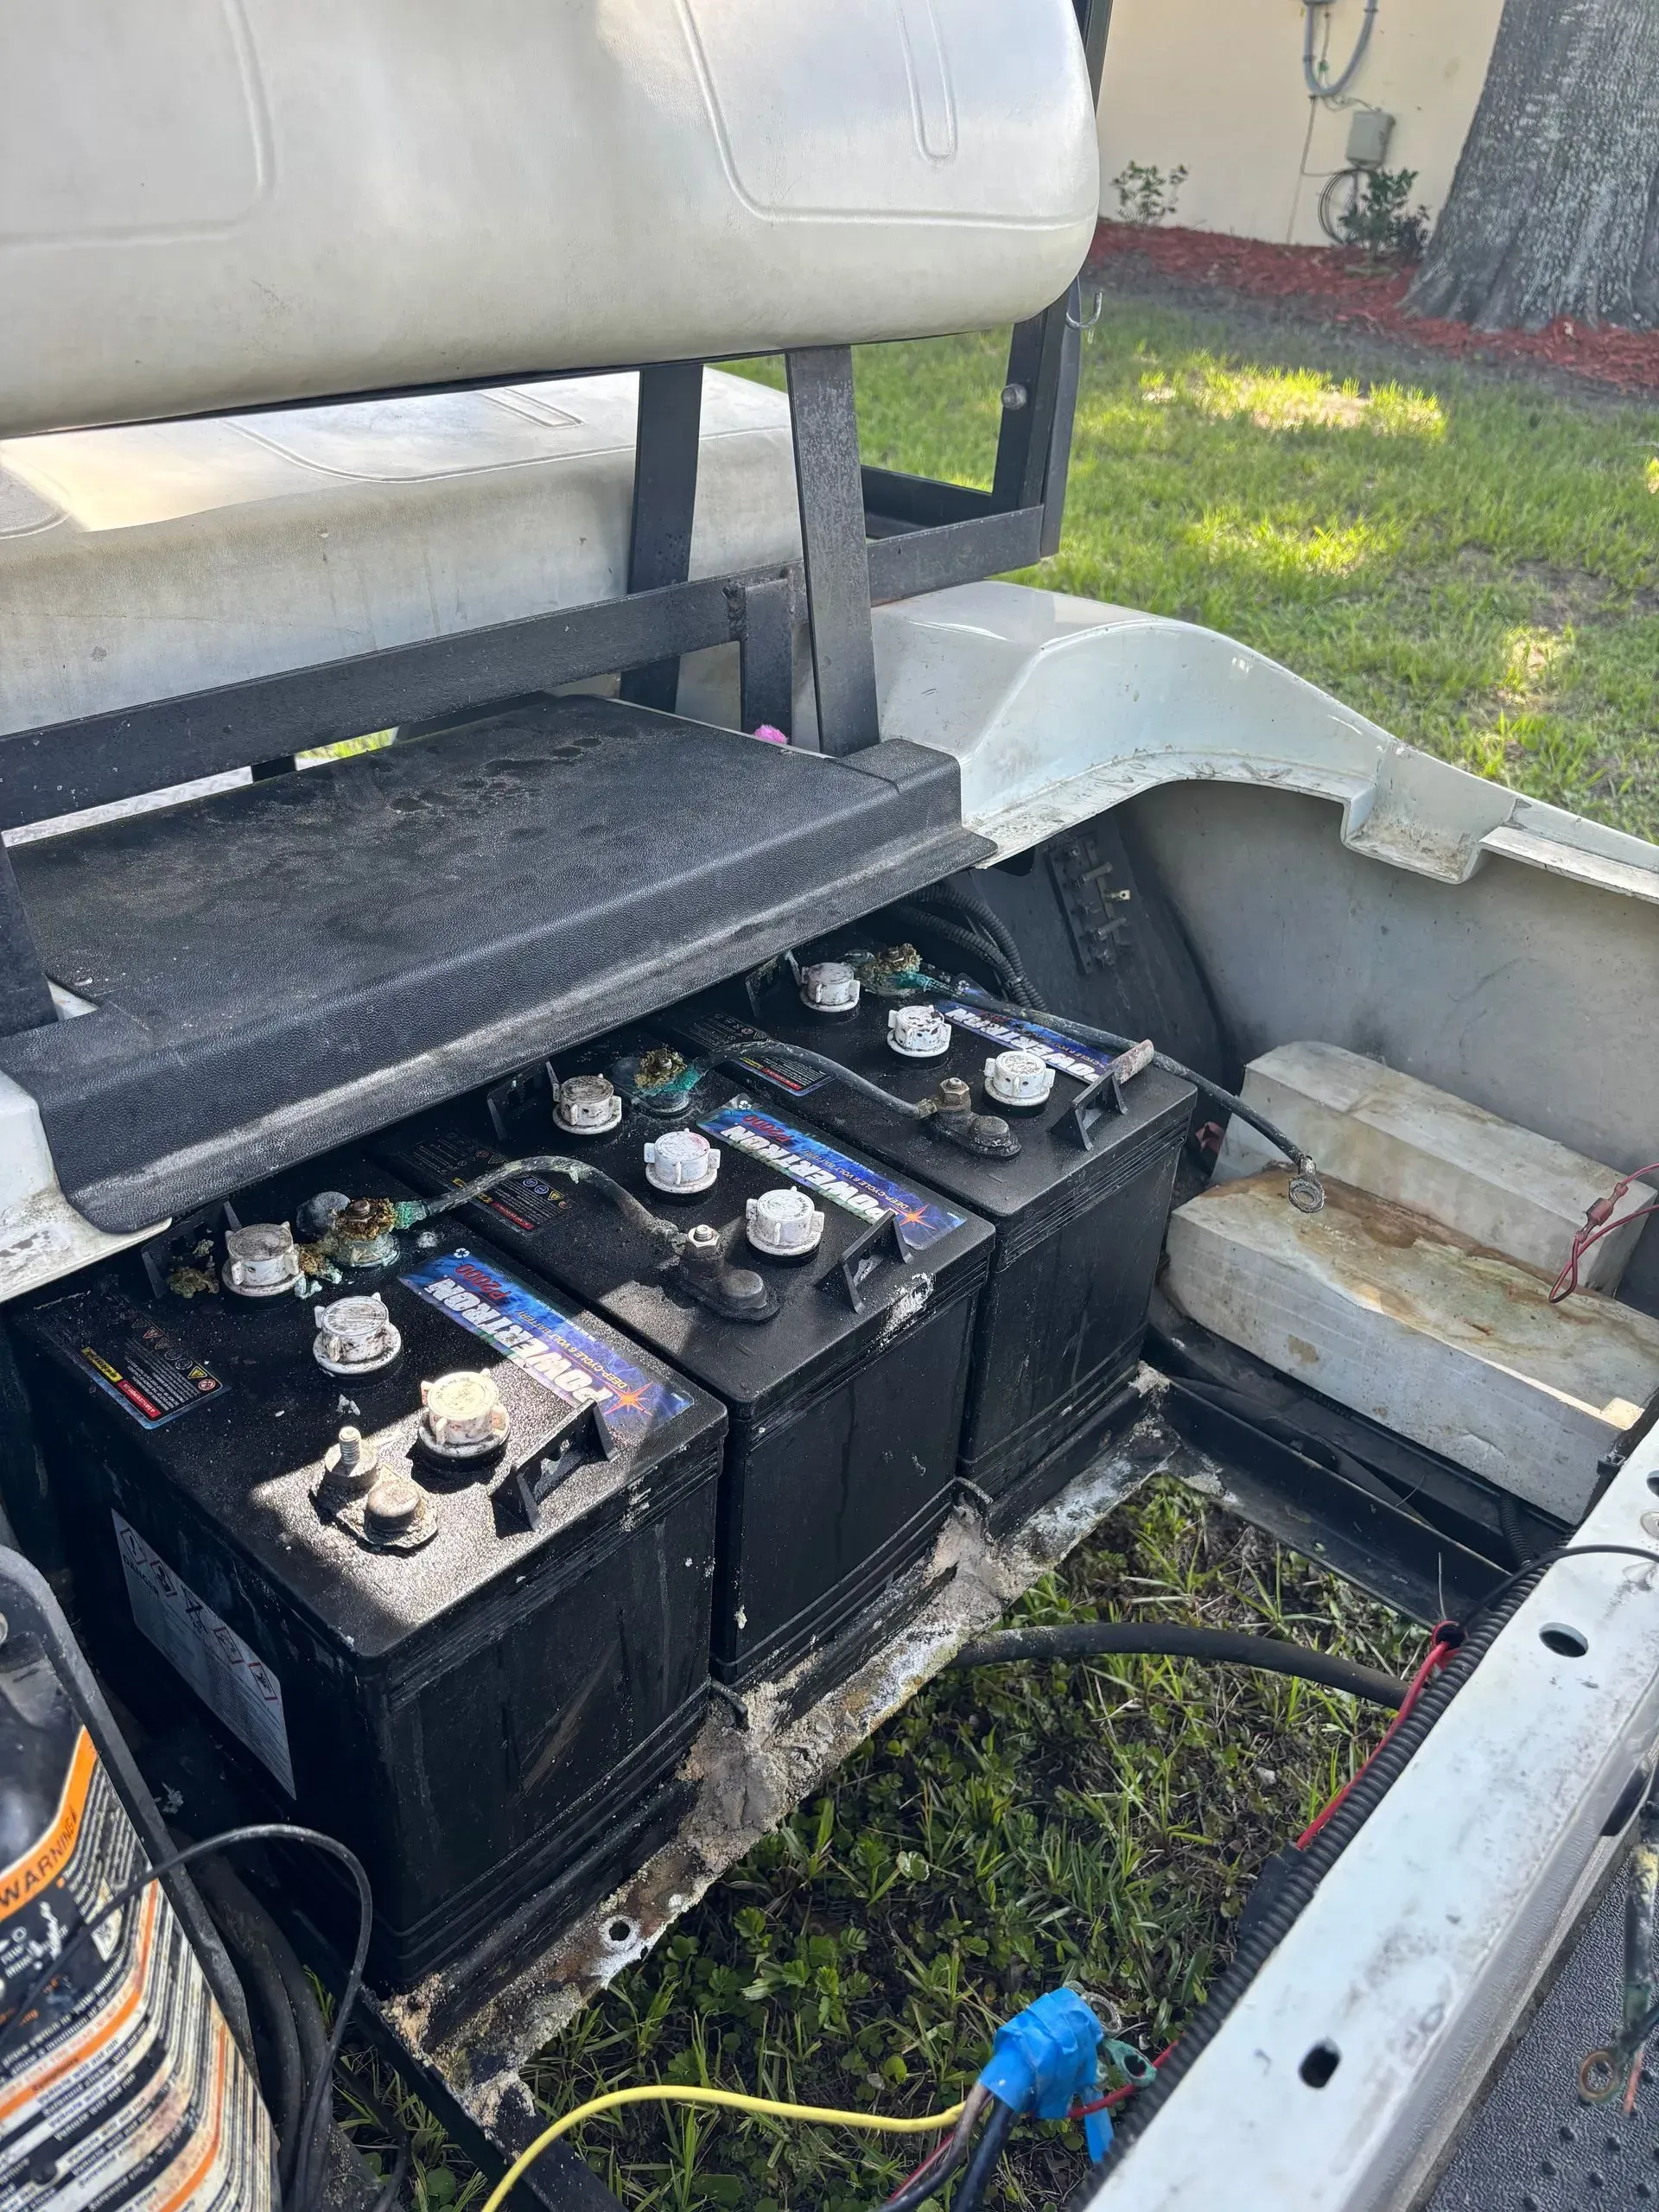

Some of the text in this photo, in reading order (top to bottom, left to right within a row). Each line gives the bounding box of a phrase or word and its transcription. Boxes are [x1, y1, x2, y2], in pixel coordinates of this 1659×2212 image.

[741, 1113, 792, 1143] P2000
[720, 1123, 899, 1221] POWERTRON
[799, 1148, 836, 1168] BATTERY
[833, 1166, 854, 1180] VOLT
[857, 1180, 909, 1210] DEEP-CYCLE
[454, 1262, 512, 1300] P2000
[514, 1309, 552, 1334] BATTERY
[424, 1277, 613, 1404] POWERTRON
[548, 1332, 571, 1349] VOLT
[569, 1345, 578, 1354] 6
[573, 1350, 628, 1389] DEEP-CYCLE
